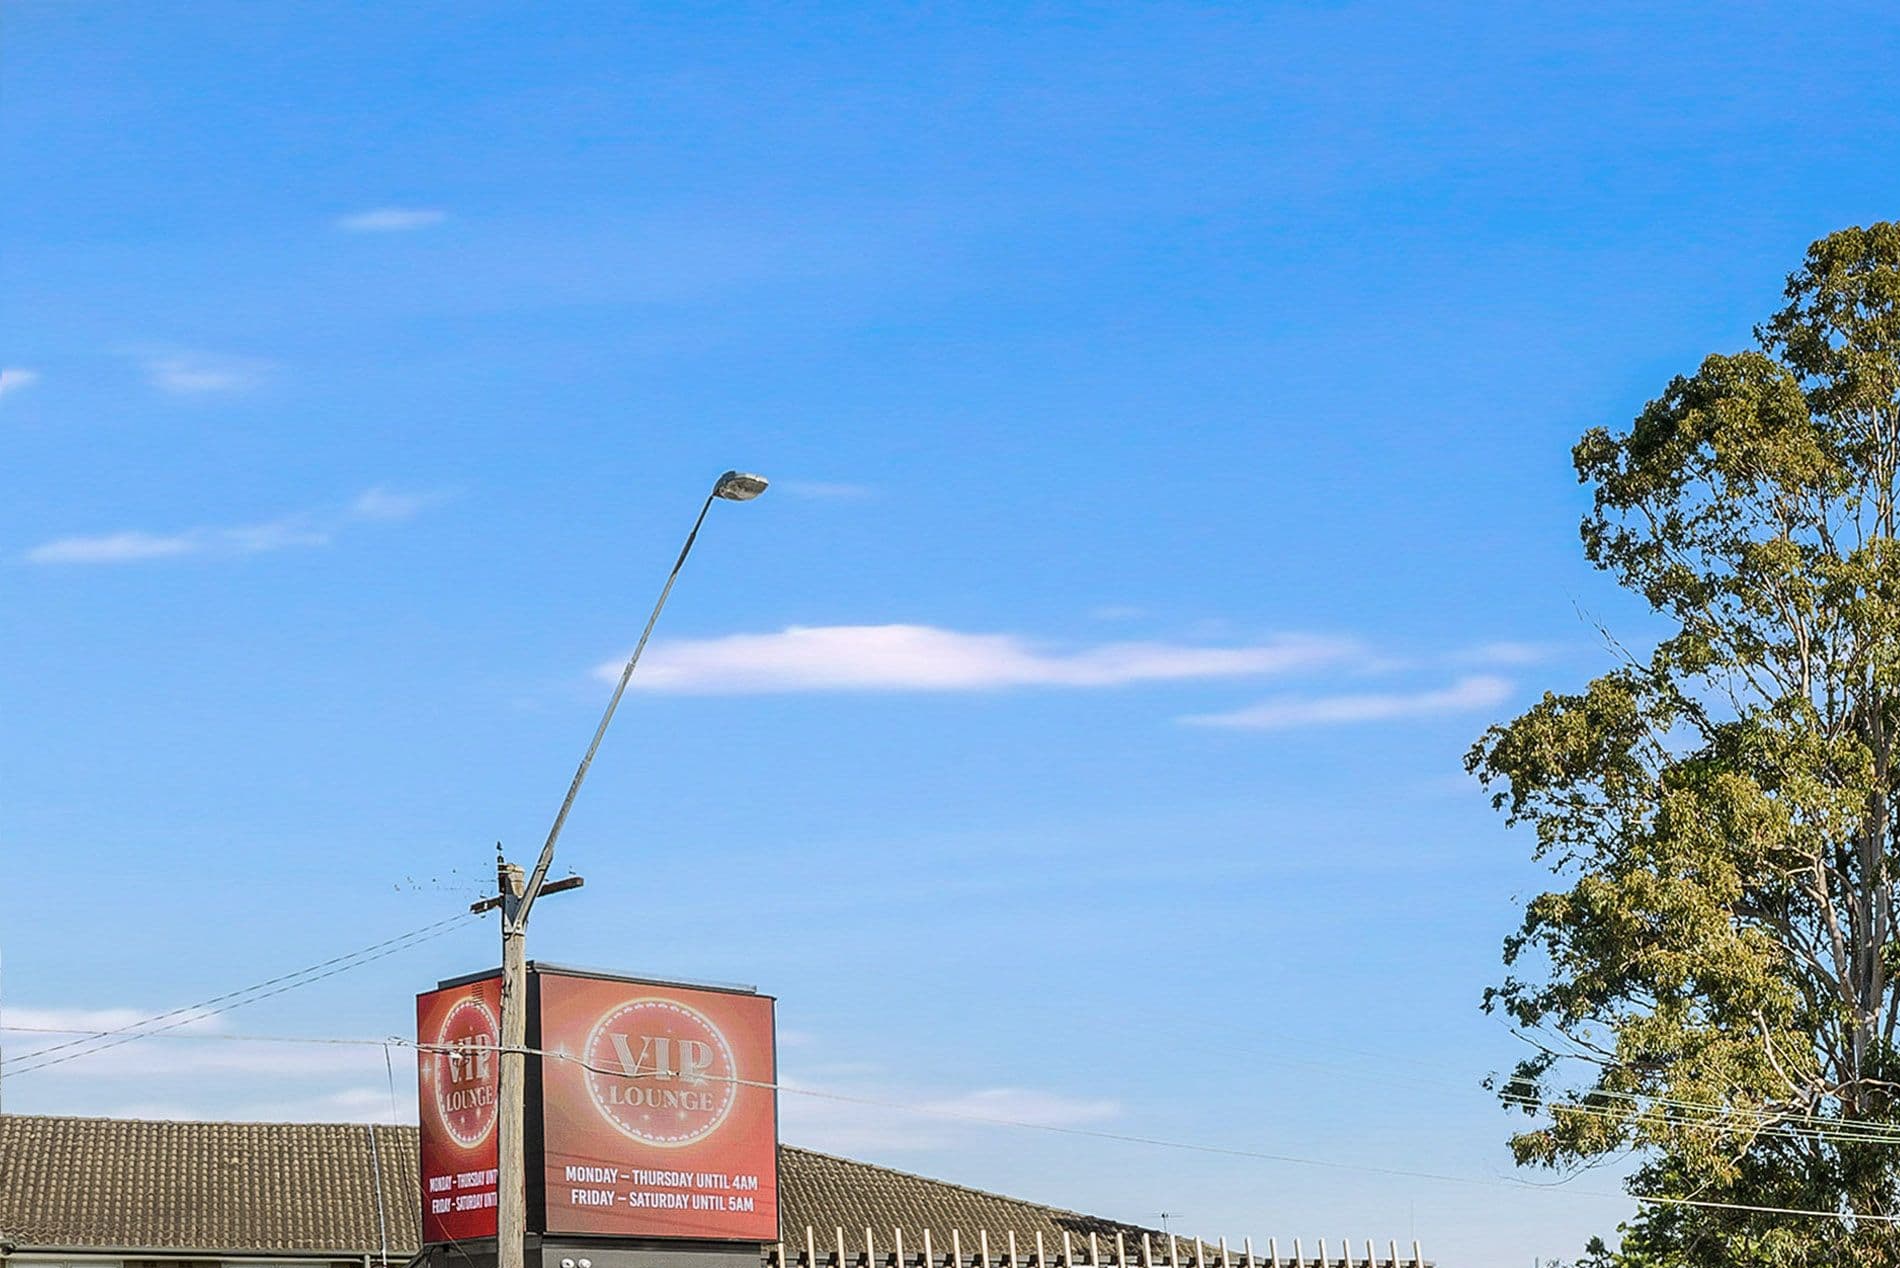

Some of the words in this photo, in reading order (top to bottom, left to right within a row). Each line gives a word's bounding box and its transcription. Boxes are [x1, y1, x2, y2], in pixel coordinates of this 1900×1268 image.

[609, 1032, 715, 1083] VIP
[446, 1084, 494, 1112] LOUNGE
[609, 1084, 715, 1112] LOUNGE
[565, 1165, 618, 1184] MONDAY
[632, 1169, 693, 1188] THURSDAY
[696, 1173, 730, 1190] UNTIL
[732, 1175, 758, 1191] 4AM
[571, 1188, 615, 1206] FRIDAY
[629, 1192, 689, 1210] SATURDAY
[692, 1195, 726, 1211] UNTIL
[728, 1196, 754, 1213] 5AM
